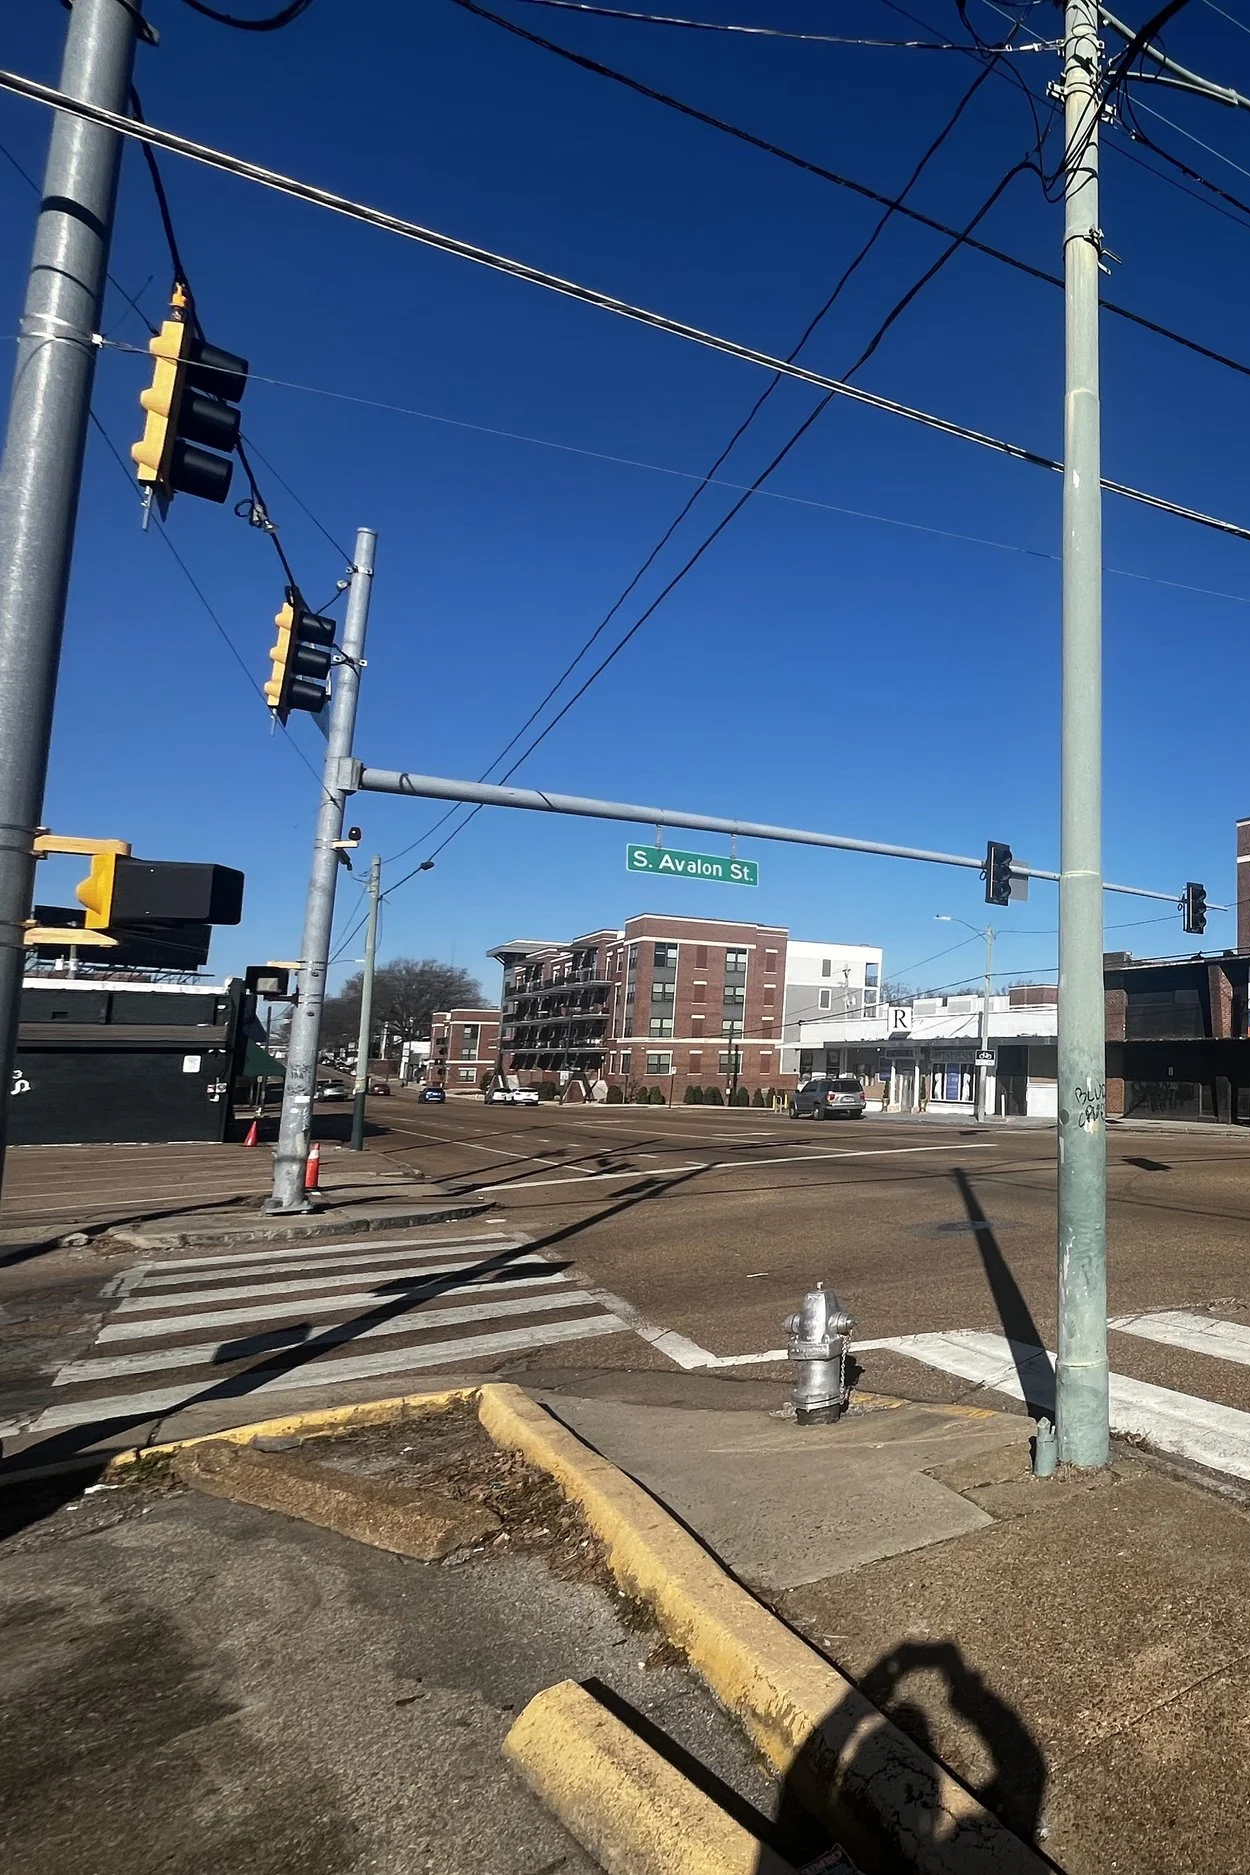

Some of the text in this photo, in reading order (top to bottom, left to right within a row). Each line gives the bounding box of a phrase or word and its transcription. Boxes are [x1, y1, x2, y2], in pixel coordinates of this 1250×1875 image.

[633, 850, 754, 881] S. Avalon St.
[894, 1009, 907, 1028] R
